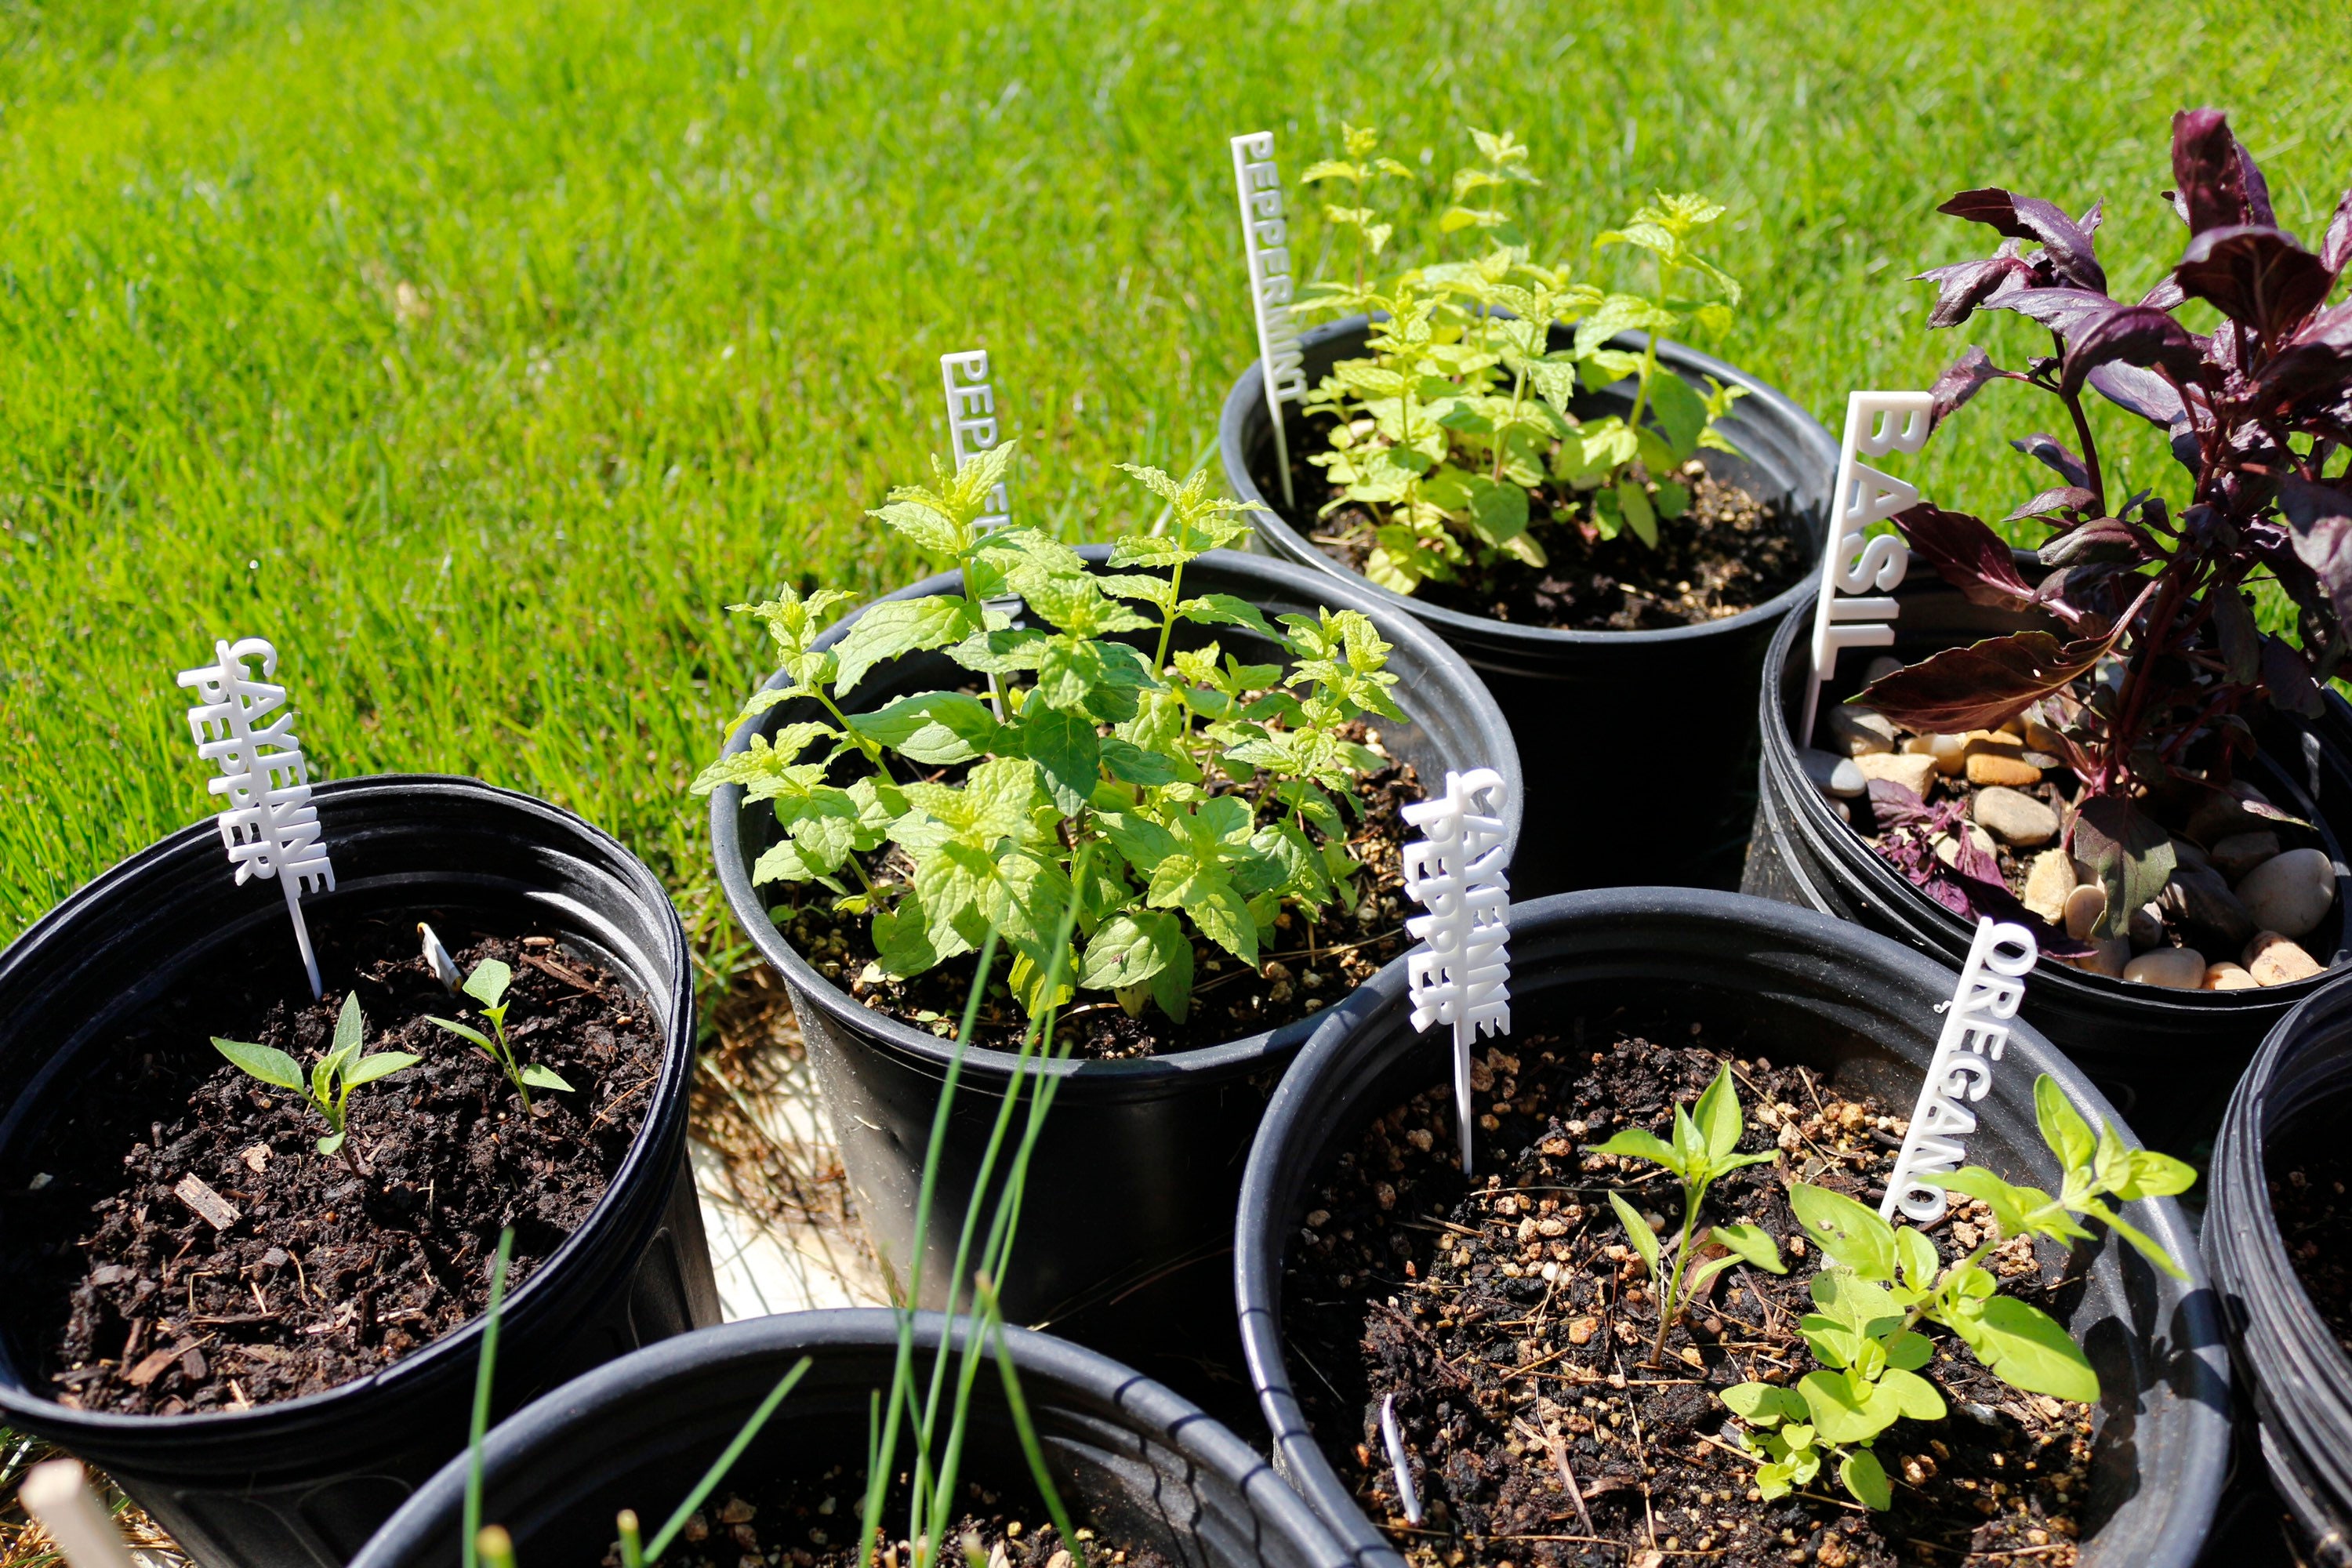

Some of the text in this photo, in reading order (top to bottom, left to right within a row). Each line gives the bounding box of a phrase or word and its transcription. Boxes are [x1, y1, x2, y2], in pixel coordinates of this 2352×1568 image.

[1232, 130, 1309, 406] PEPPERMINT
[941, 350, 1024, 632] PEPERI
[1814, 391, 1936, 681] BASIL
[176, 664, 278, 887] PEPPER
[229, 637, 336, 900] CAYENNE
[1459, 768, 1511, 1044] CAYENNE
[1400, 797, 1459, 1033] PEPPER
[1894, 920, 2039, 1222] OREGANO
